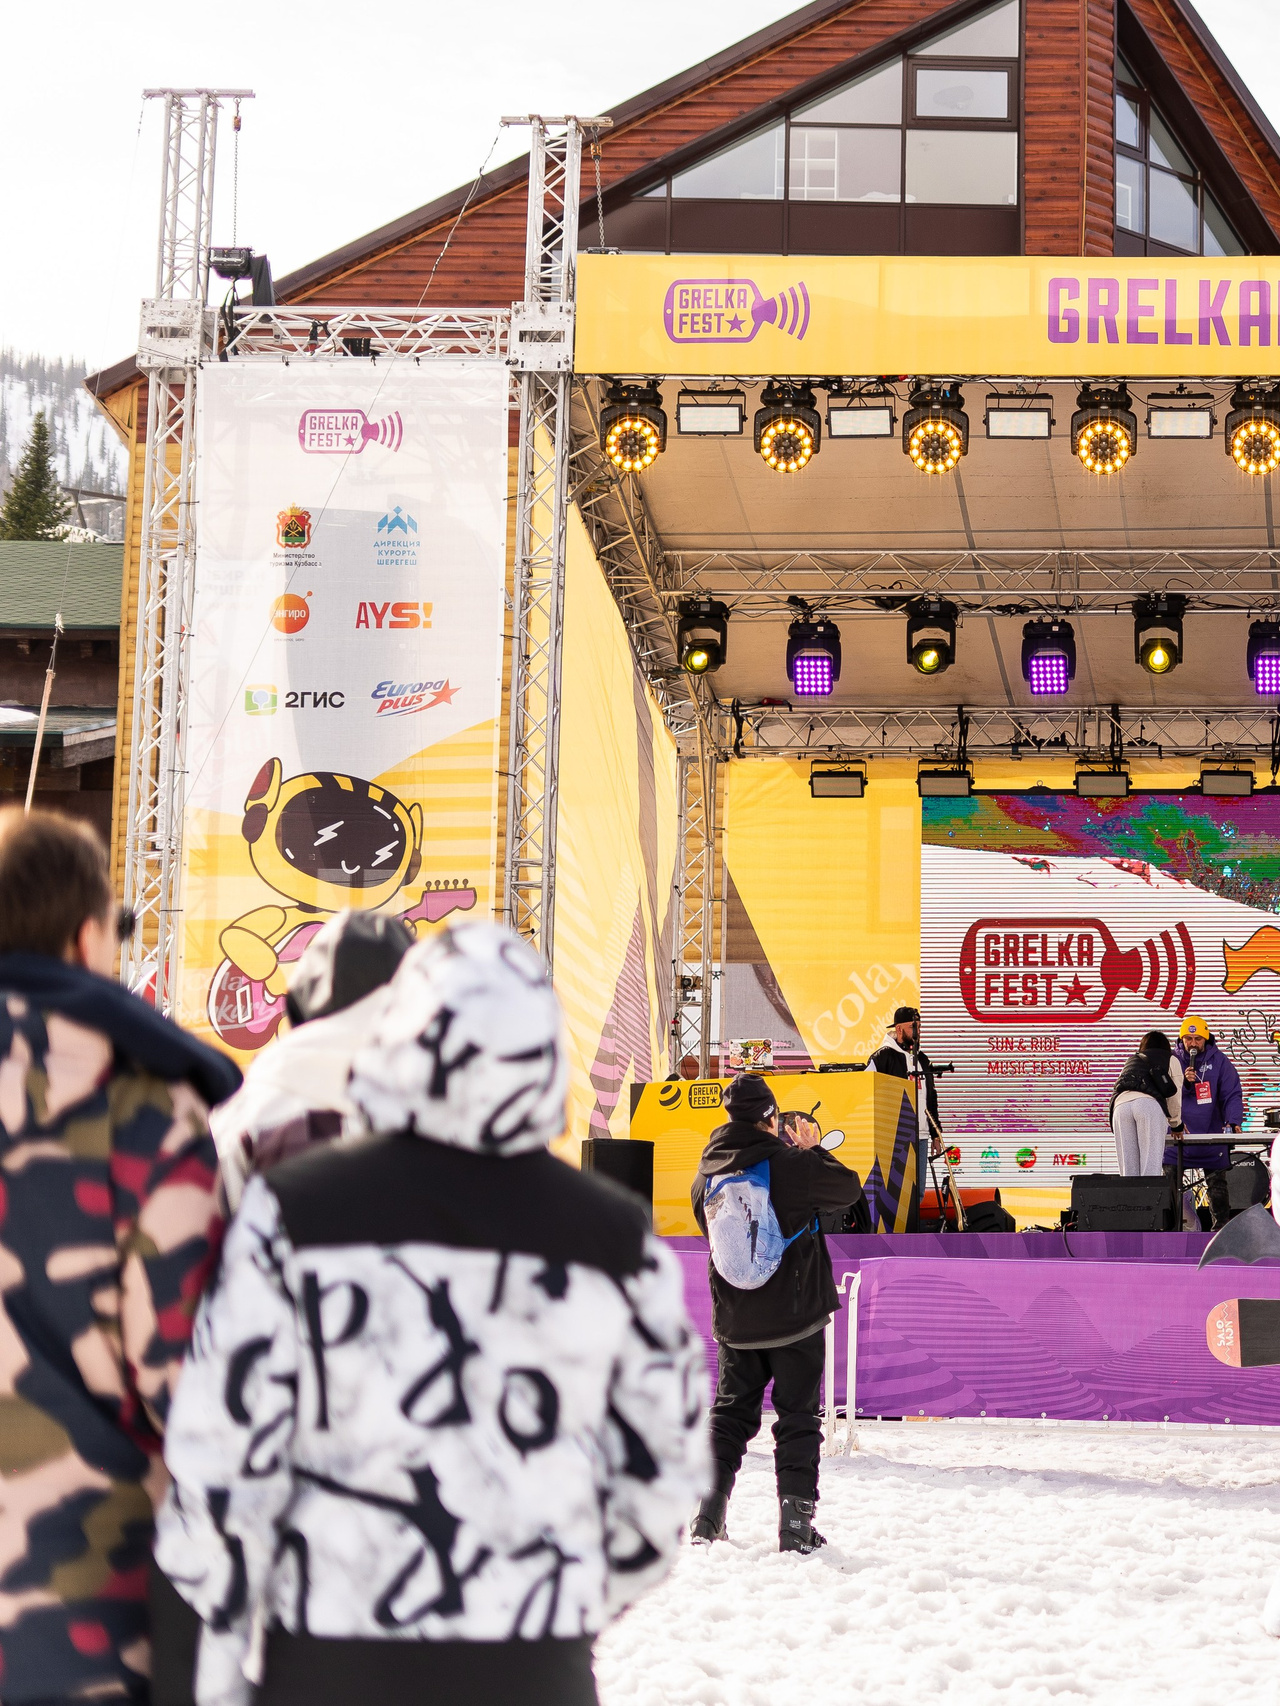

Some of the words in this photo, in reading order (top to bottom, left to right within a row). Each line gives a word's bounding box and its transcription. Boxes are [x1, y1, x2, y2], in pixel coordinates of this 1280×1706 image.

[678, 288, 747, 310] GRELKA
[678, 313, 725, 334] FEST
[309, 415, 359, 430] GRELKA
[309, 432, 342, 447] FEST
[373, 540, 421, 548] ДИРЕКЦИЯ
[377, 558, 417, 566] ШЕРЕГЕШ
[355, 601, 434, 629] AYS!
[284, 691, 346, 709] 2ГИС
[983, 933, 1094, 967] GRELKA
[983, 973, 1059, 1007] FEST
[987, 1036, 1014, 1052] SUN
[1016, 1037, 1027, 1052] &
[1030, 1036, 1061, 1052] RIDE
[987, 1060, 1030, 1075] MUSIC
[1032, 1060, 1093, 1075] FESTIVAL
[693, 1086, 719, 1096] GRELKA
[693, 1096, 711, 1106] FEST
